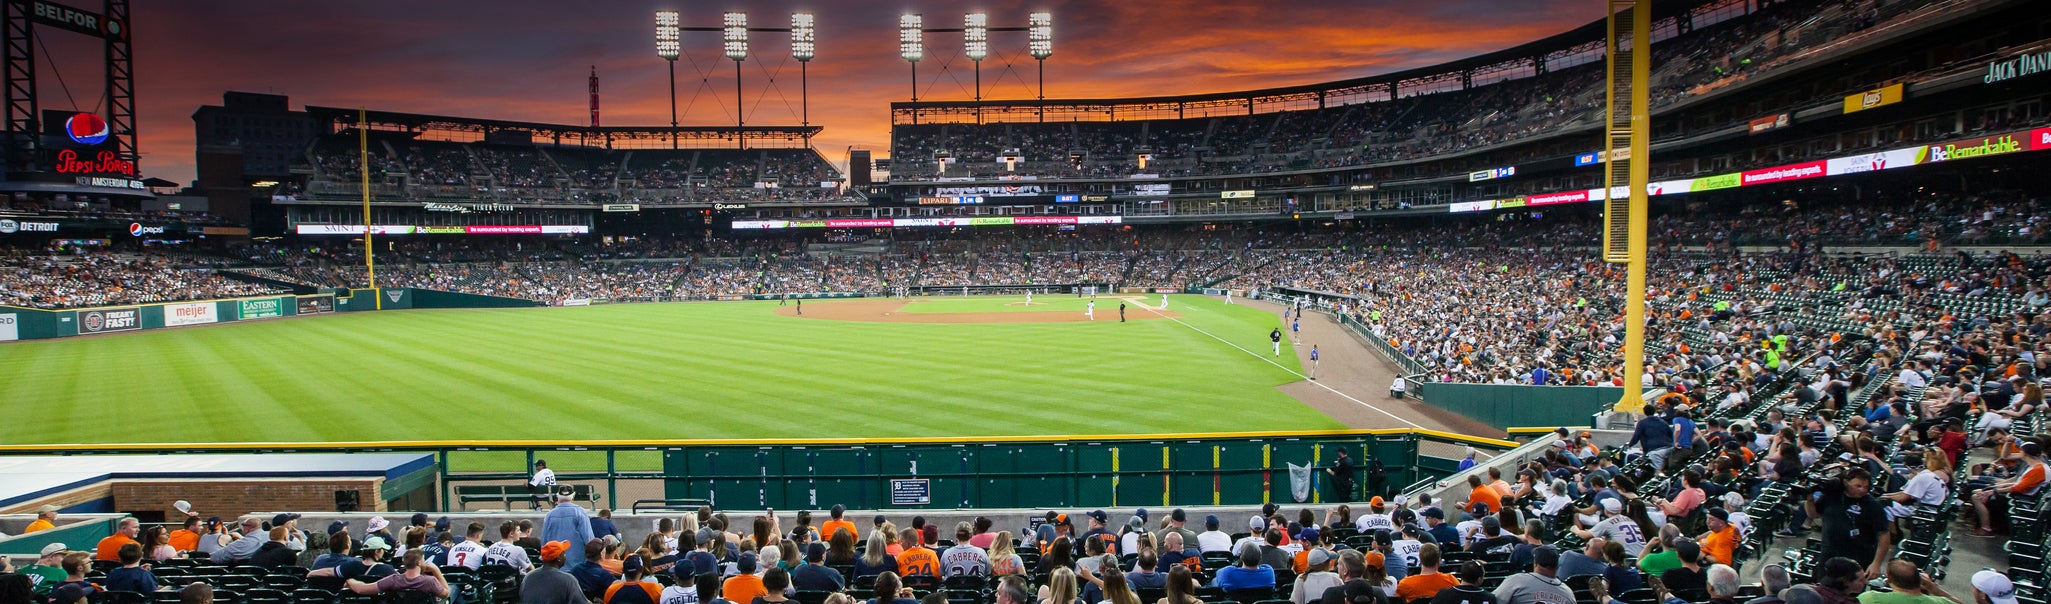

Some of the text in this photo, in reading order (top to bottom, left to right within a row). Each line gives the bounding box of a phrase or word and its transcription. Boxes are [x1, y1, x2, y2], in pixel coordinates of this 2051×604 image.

[34, 1, 97, 29] BELFOR
[1983, 59, 2017, 84] JACK
[20, 221, 59, 231] DETROIT
[142, 226, 163, 235] pepsi
[243, 300, 277, 310] EASTERN
[106, 311, 135, 319] FREAKY
[176, 305, 207, 318] meijer
[105, 317, 135, 328] FAST!
[545, 476, 555, 485] 95
[1618, 524, 1646, 544] 35
[489, 546, 512, 559] FIELDER
[948, 552, 984, 564] CABRERA
[455, 552, 467, 567] 3
[904, 553, 932, 566] CABRERA
